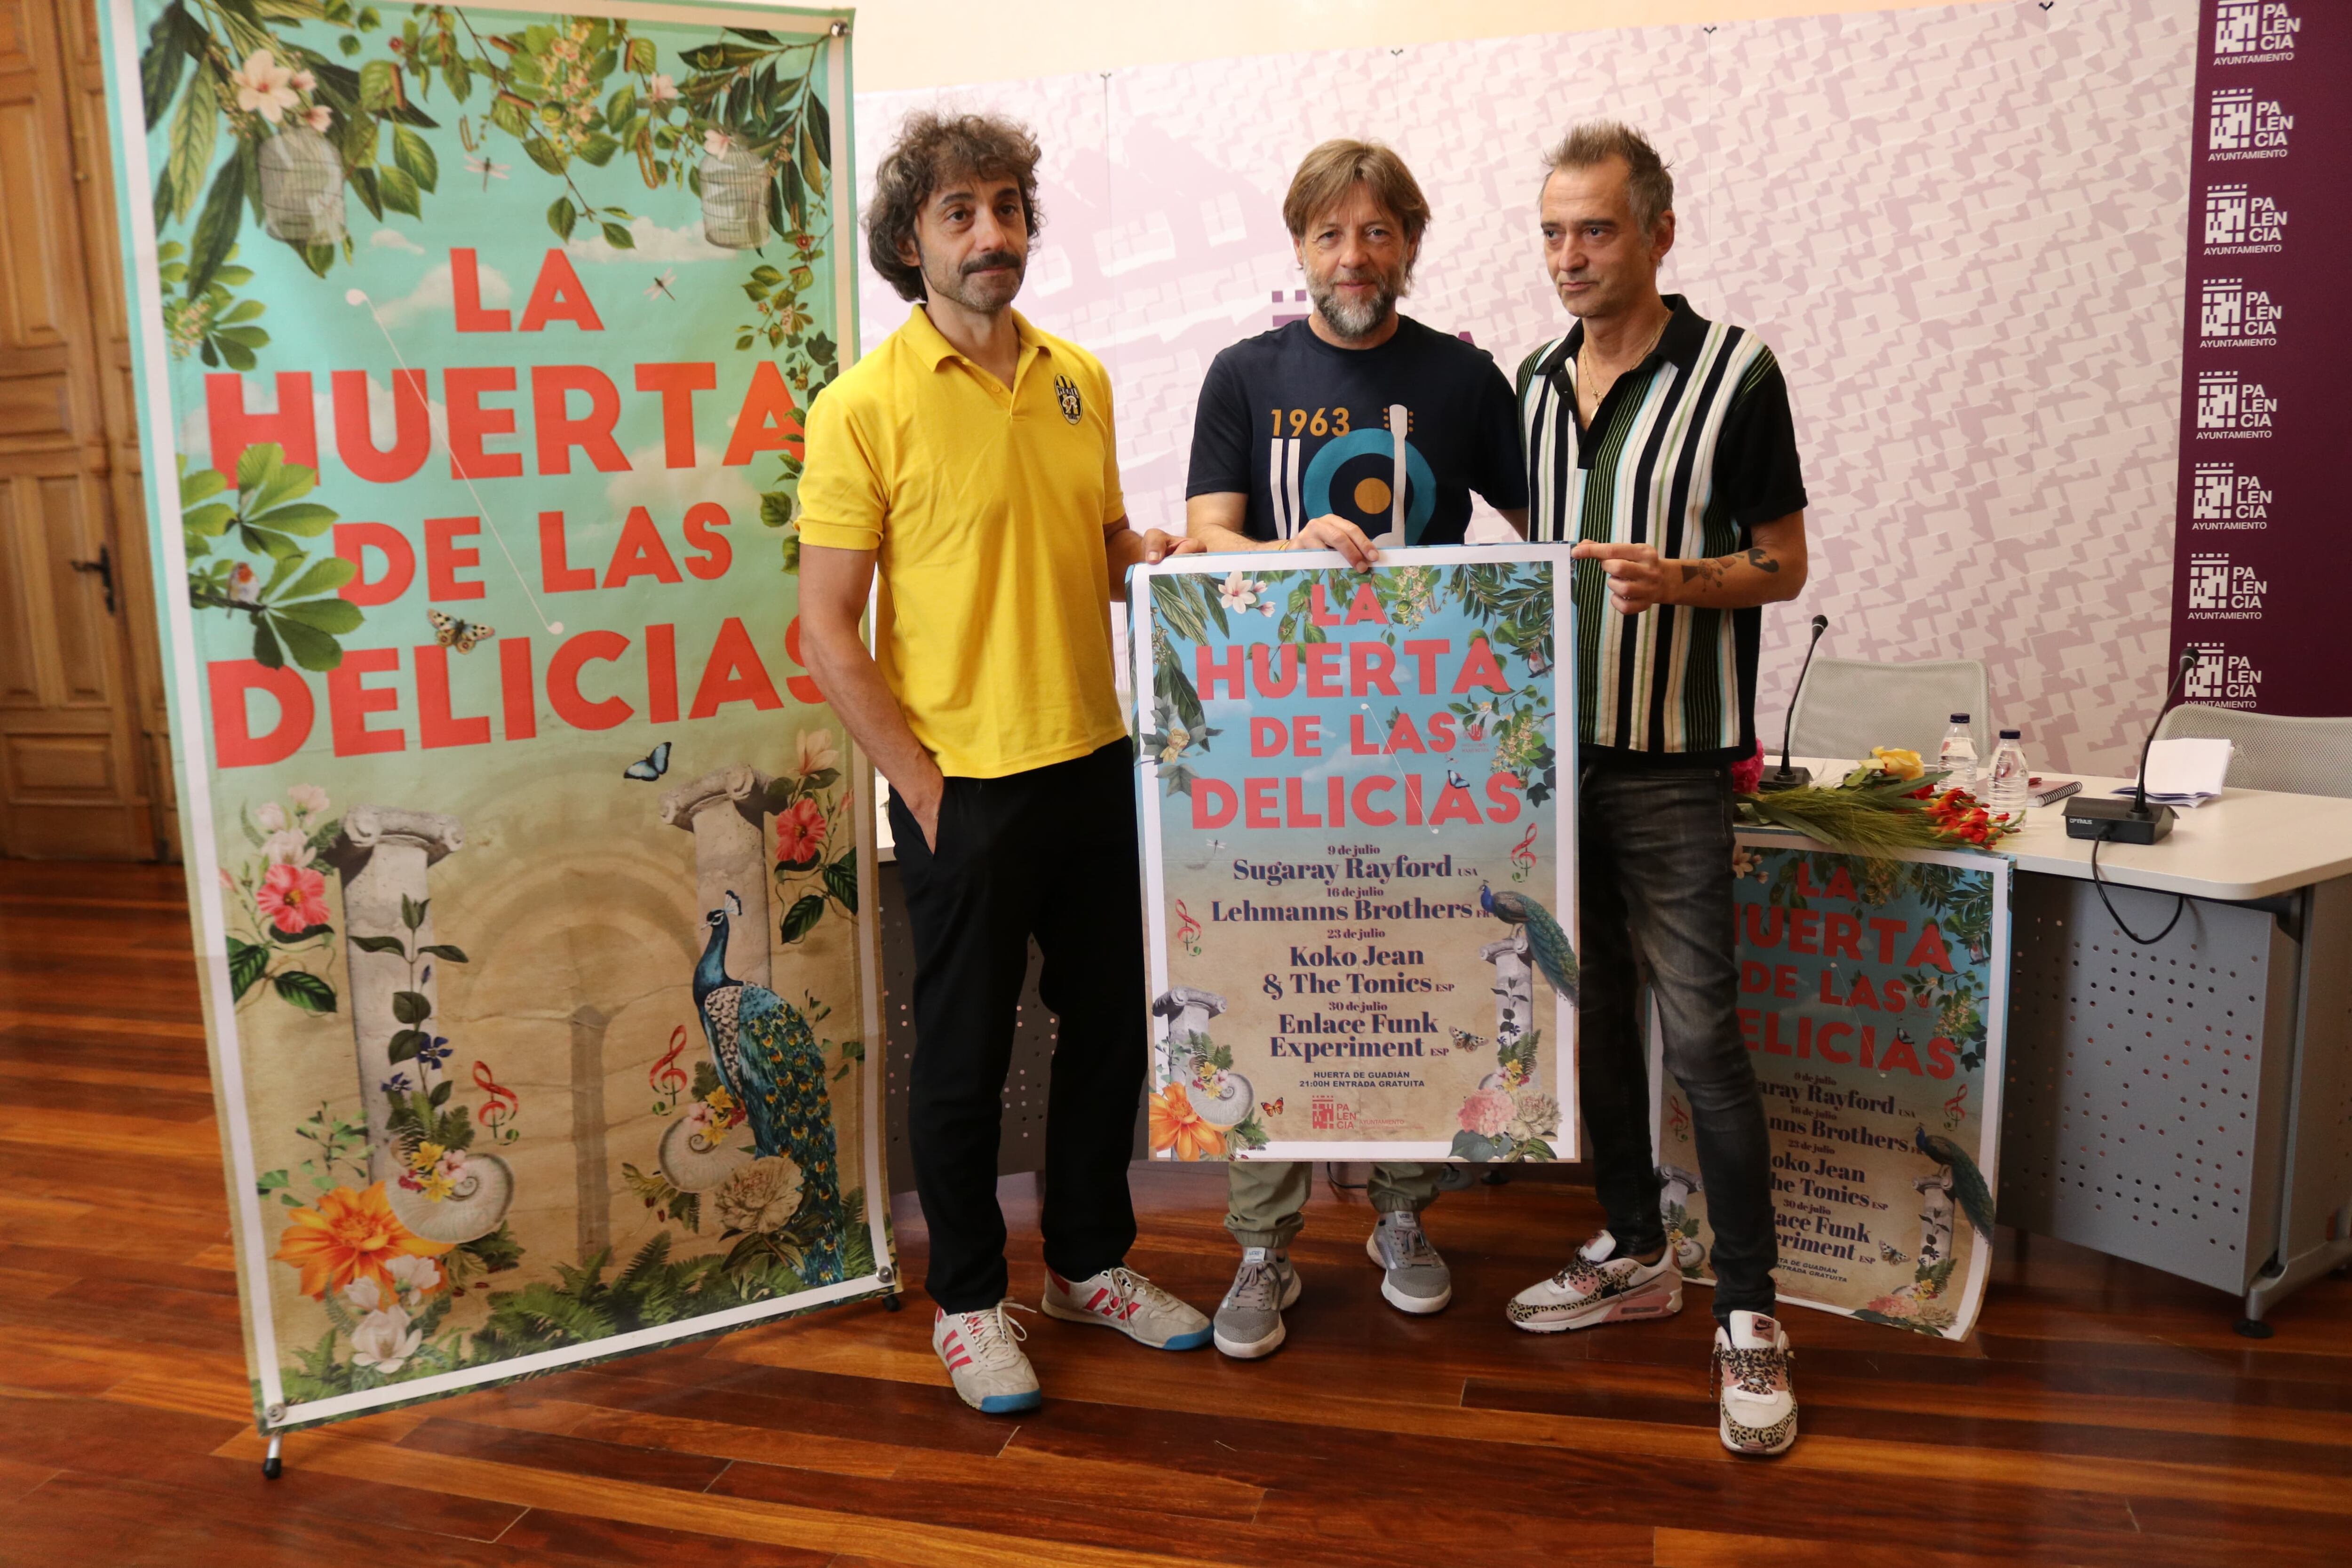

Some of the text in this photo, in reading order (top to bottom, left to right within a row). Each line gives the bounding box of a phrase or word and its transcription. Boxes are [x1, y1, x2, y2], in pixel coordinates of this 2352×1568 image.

[2263, 3, 2288, 19] PA
[2262, 17, 2301, 35] LEN
[2260, 34, 2294, 50] CIA
[2213, 52, 2294, 65] AYUNTAMIENTO
[2256, 101, 2281, 116] PA
[2255, 115, 2294, 132] LEN
[2254, 131, 2288, 147] CIA
[2208, 149, 2288, 161] AYUNTAMIENTO
[2251, 197, 2275, 212] PA
[2250, 211, 2288, 227] LEN
[2249, 227, 2282, 242] CIA
[2203, 244, 2282, 255] AYUNTAMIENTO
[450, 247, 604, 333] LA
[2246, 291, 2270, 305] PA
[2245, 305, 2282, 320] LEN
[2244, 321, 2276, 335] CIA
[2200, 338, 2277, 348] AYUNTAMIENTO
[2242, 384, 2265, 398] PA
[2241, 398, 2277, 413] LEN
[204, 361, 805, 491] HUERTA
[1271, 407, 1350, 437] 1963
[2240, 414, 2272, 428] CIA
[2196, 430, 2272, 439] AYUNTAMIENTO
[2238, 476, 2261, 489] PA
[2237, 490, 2272, 504] LEN
[2236, 505, 2267, 518] CIA
[2192, 522, 2267, 530] AYUNTAMIENTO
[332, 501, 732, 607] DE LAS
[2233, 566, 2256, 580] PA
[2232, 581, 2267, 594] LEN
[1311, 583, 1389, 626] LA
[2231, 595, 2262, 609] CIA
[1196, 638, 1510, 700] HUERTA
[2228, 656, 2250, 669] PA
[2227, 670, 2262, 683] LEN
[2226, 684, 2257, 697] CIA
[1250, 712, 1456, 757] DE LAS
[1191, 772, 1521, 829] DELICIAS
[1327, 844, 1380, 857] 9 de julio
[1233, 854, 1478, 886] Sugaray Rayford USA
[1797, 862, 1859, 902] LA
[1327, 886, 1384, 899] 16 de julio
[1211, 899, 1349, 922] Lehmanns
[1354, 897, 1473, 920] Brothers
[1327, 928, 1385, 940] 23 de julio
[1290, 945, 1424, 966] Koko Jean
[1263, 972, 1454, 1000] & The Tonics ESP
[1741, 960, 1907, 1013] DE LAS
[1328, 1001, 1388, 1014] 30 de julio
[1279, 1011, 1439, 1035] Enlace Funk
[1271, 1036, 1425, 1063] Experiment
[1736, 1007, 1956, 1080] ELICIAS
[1802, 1073, 1813, 1082] de
[1814, 1074, 1837, 1086] julio
[1757, 1080, 1917, 1119] aray Rayford USA
[1790, 1105, 1837, 1120] 16 de julio
[1336, 1121, 1355, 1130] CIA
[1812, 1119, 1908, 1153] Brothers
[1911, 1146, 1923, 1155] FR
[1788, 1139, 1836, 1155] 23 de julio
[1772, 1152, 1866, 1183] oko Jean
[1771, 1171, 1889, 1211] he Tonics ESP
[1783, 1199, 1832, 1216] 30 de julio
[1772, 1205, 1871, 1244] lace Funk
[1775, 1231, 1876, 1265] riment ESP
[1775, 1264, 1848, 1283] NTRADA GRATUITA
